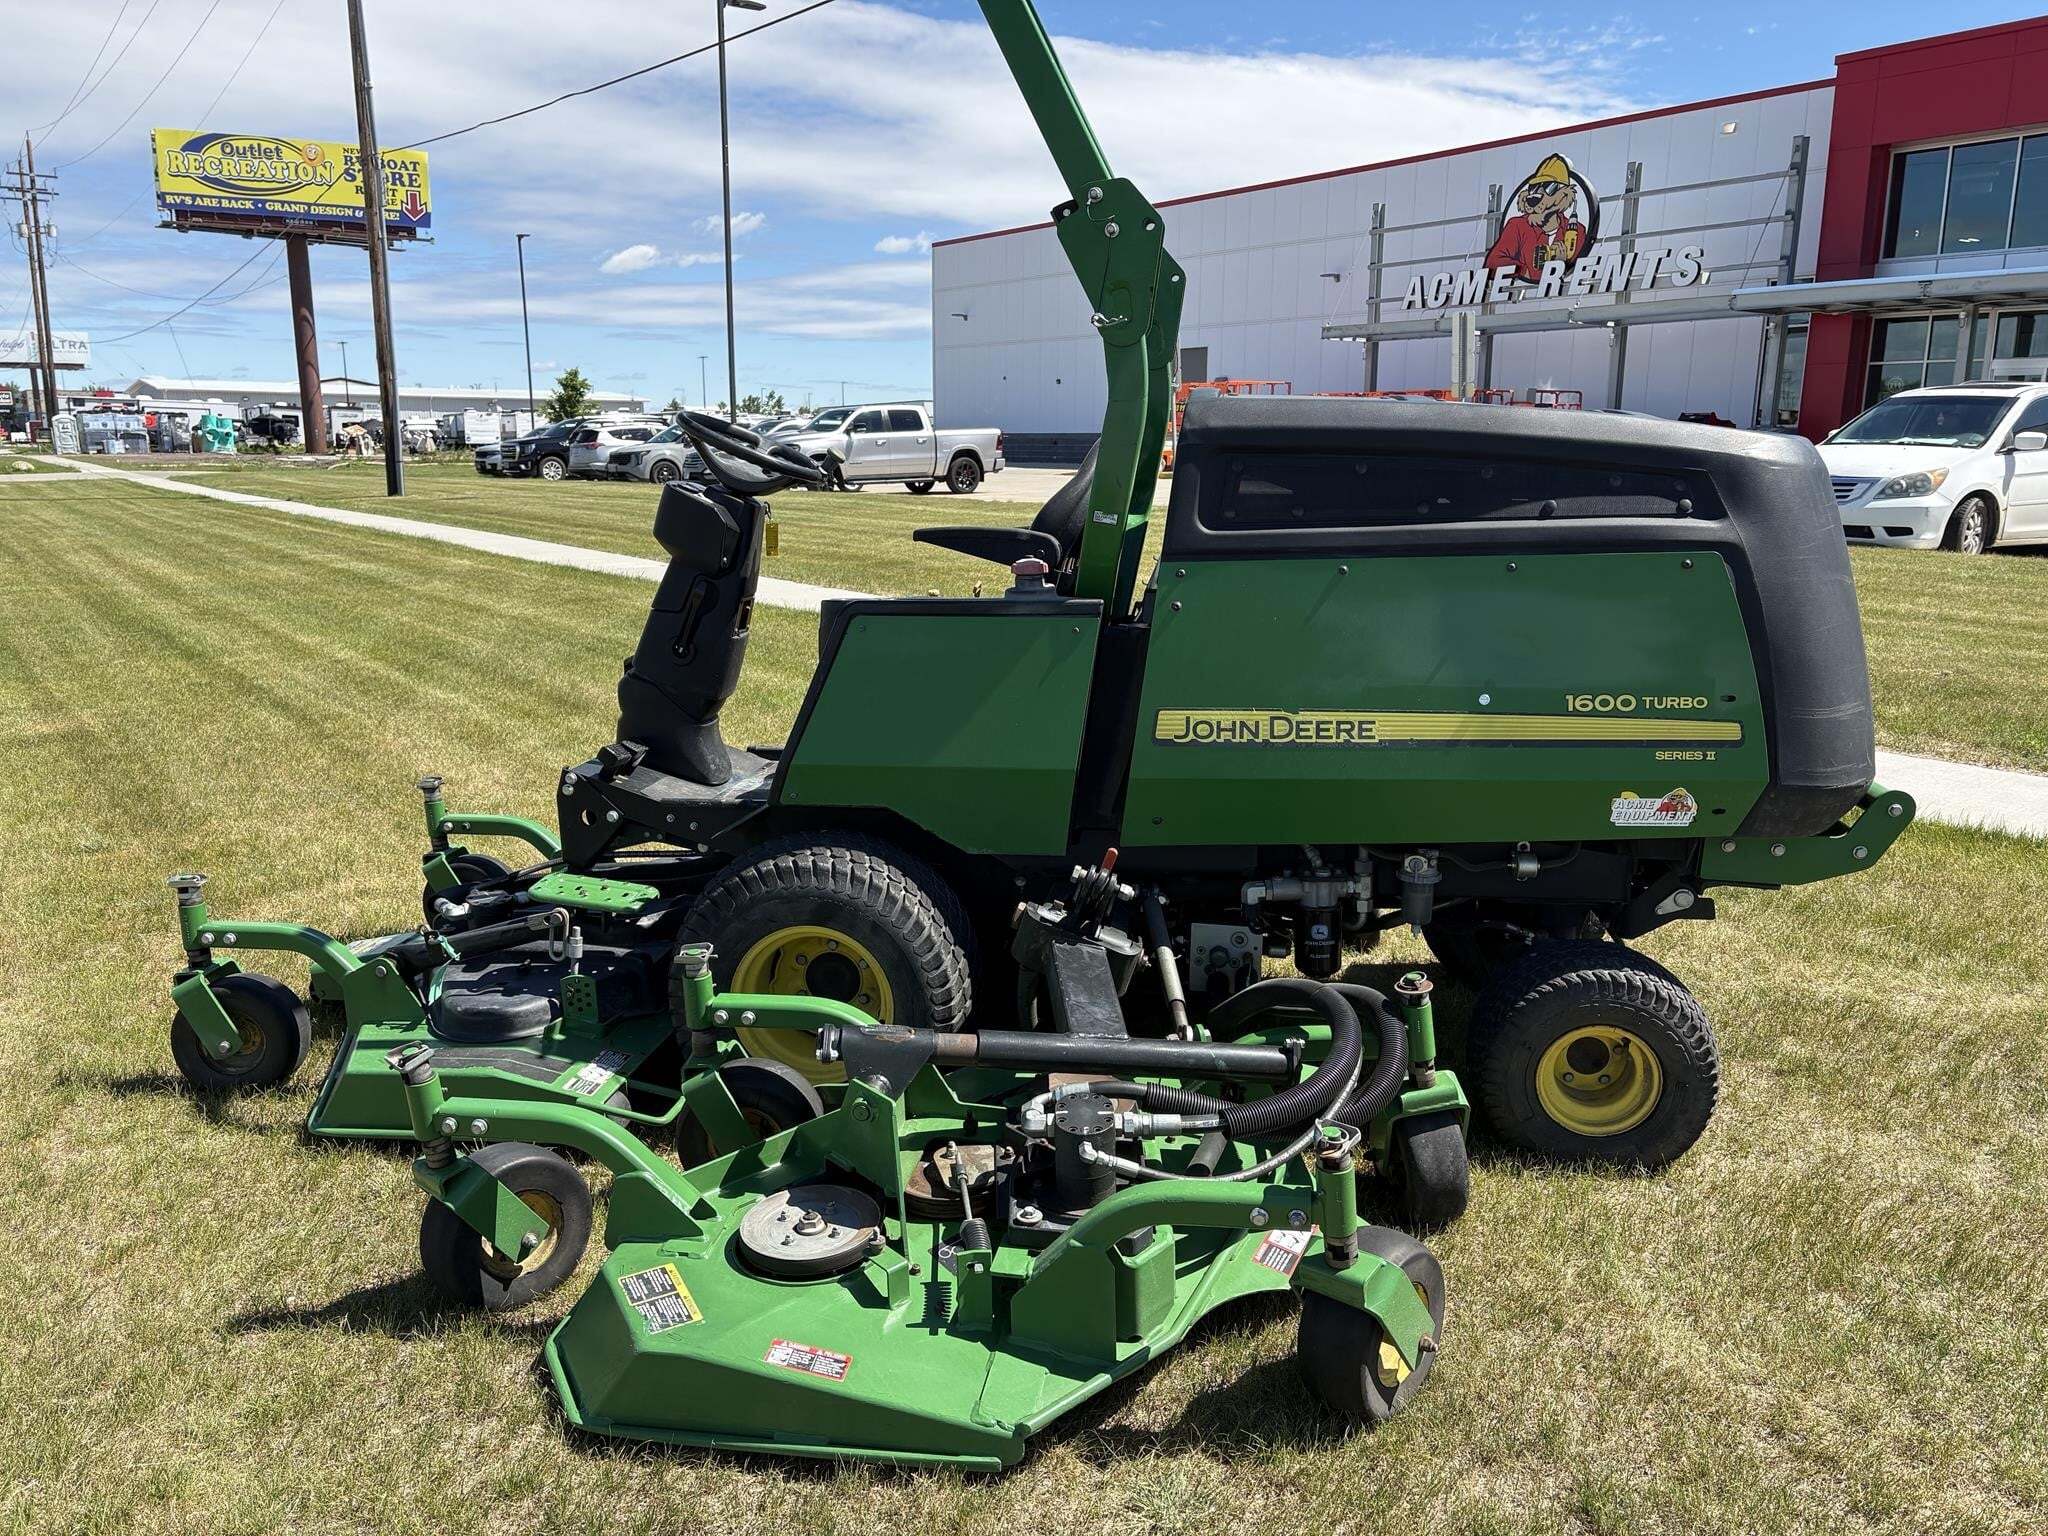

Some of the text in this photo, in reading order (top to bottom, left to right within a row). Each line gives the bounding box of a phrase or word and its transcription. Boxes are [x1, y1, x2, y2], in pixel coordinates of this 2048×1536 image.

[221, 141, 284, 160] Outlet
[167, 149, 335, 185] RECREATION
[165, 194, 193, 206] RV'S
[194, 197, 220, 208] ARE
[221, 199, 255, 210] BACK
[265, 201, 308, 214] GRAND
[310, 205, 353, 217] DESIGN
[1400, 264, 1520, 310] ACME
[1565, 694, 1708, 712] 1600 TURBO
[1173, 715, 1377, 740] JOHN DEERE
[1655, 751, 1704, 761] SERIES
[1613, 799, 1656, 810] ACME
[1611, 810, 1695, 822] EQUIPMENT
